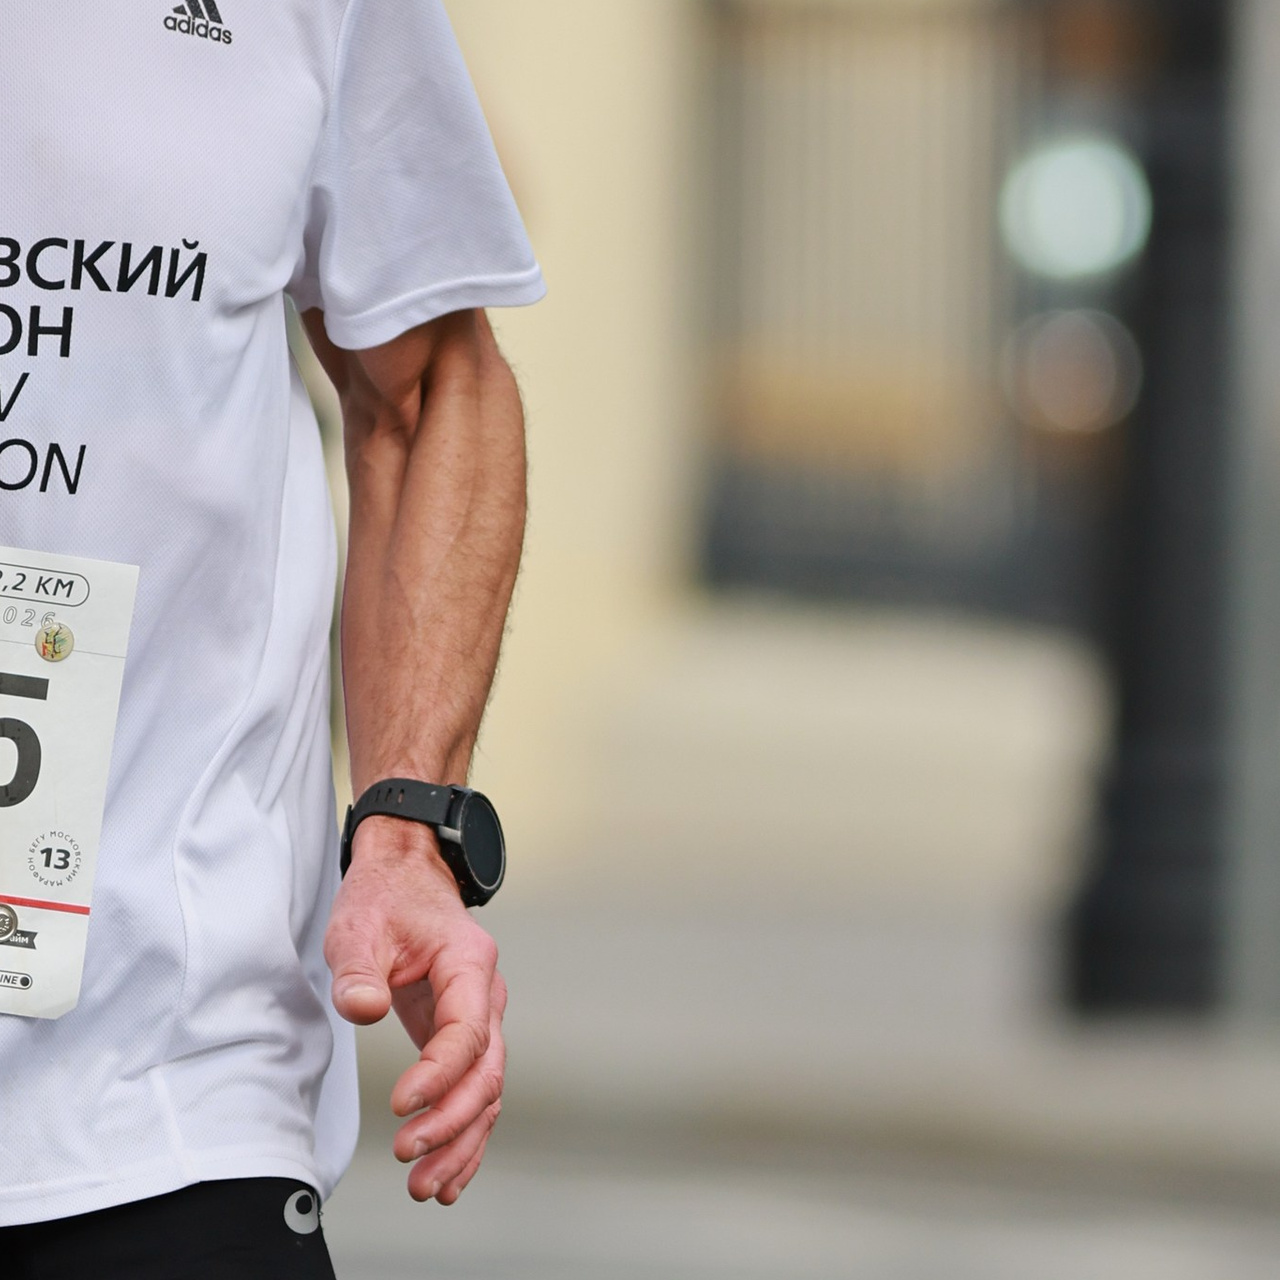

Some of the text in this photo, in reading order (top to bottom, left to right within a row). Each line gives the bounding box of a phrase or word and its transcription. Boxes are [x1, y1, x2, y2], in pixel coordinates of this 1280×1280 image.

[163, 15, 233, 45] adidas
[35, 575, 75, 598] КМ
[28, 833, 45, 854] БЕГУ
[39, 847, 71, 870] 13
